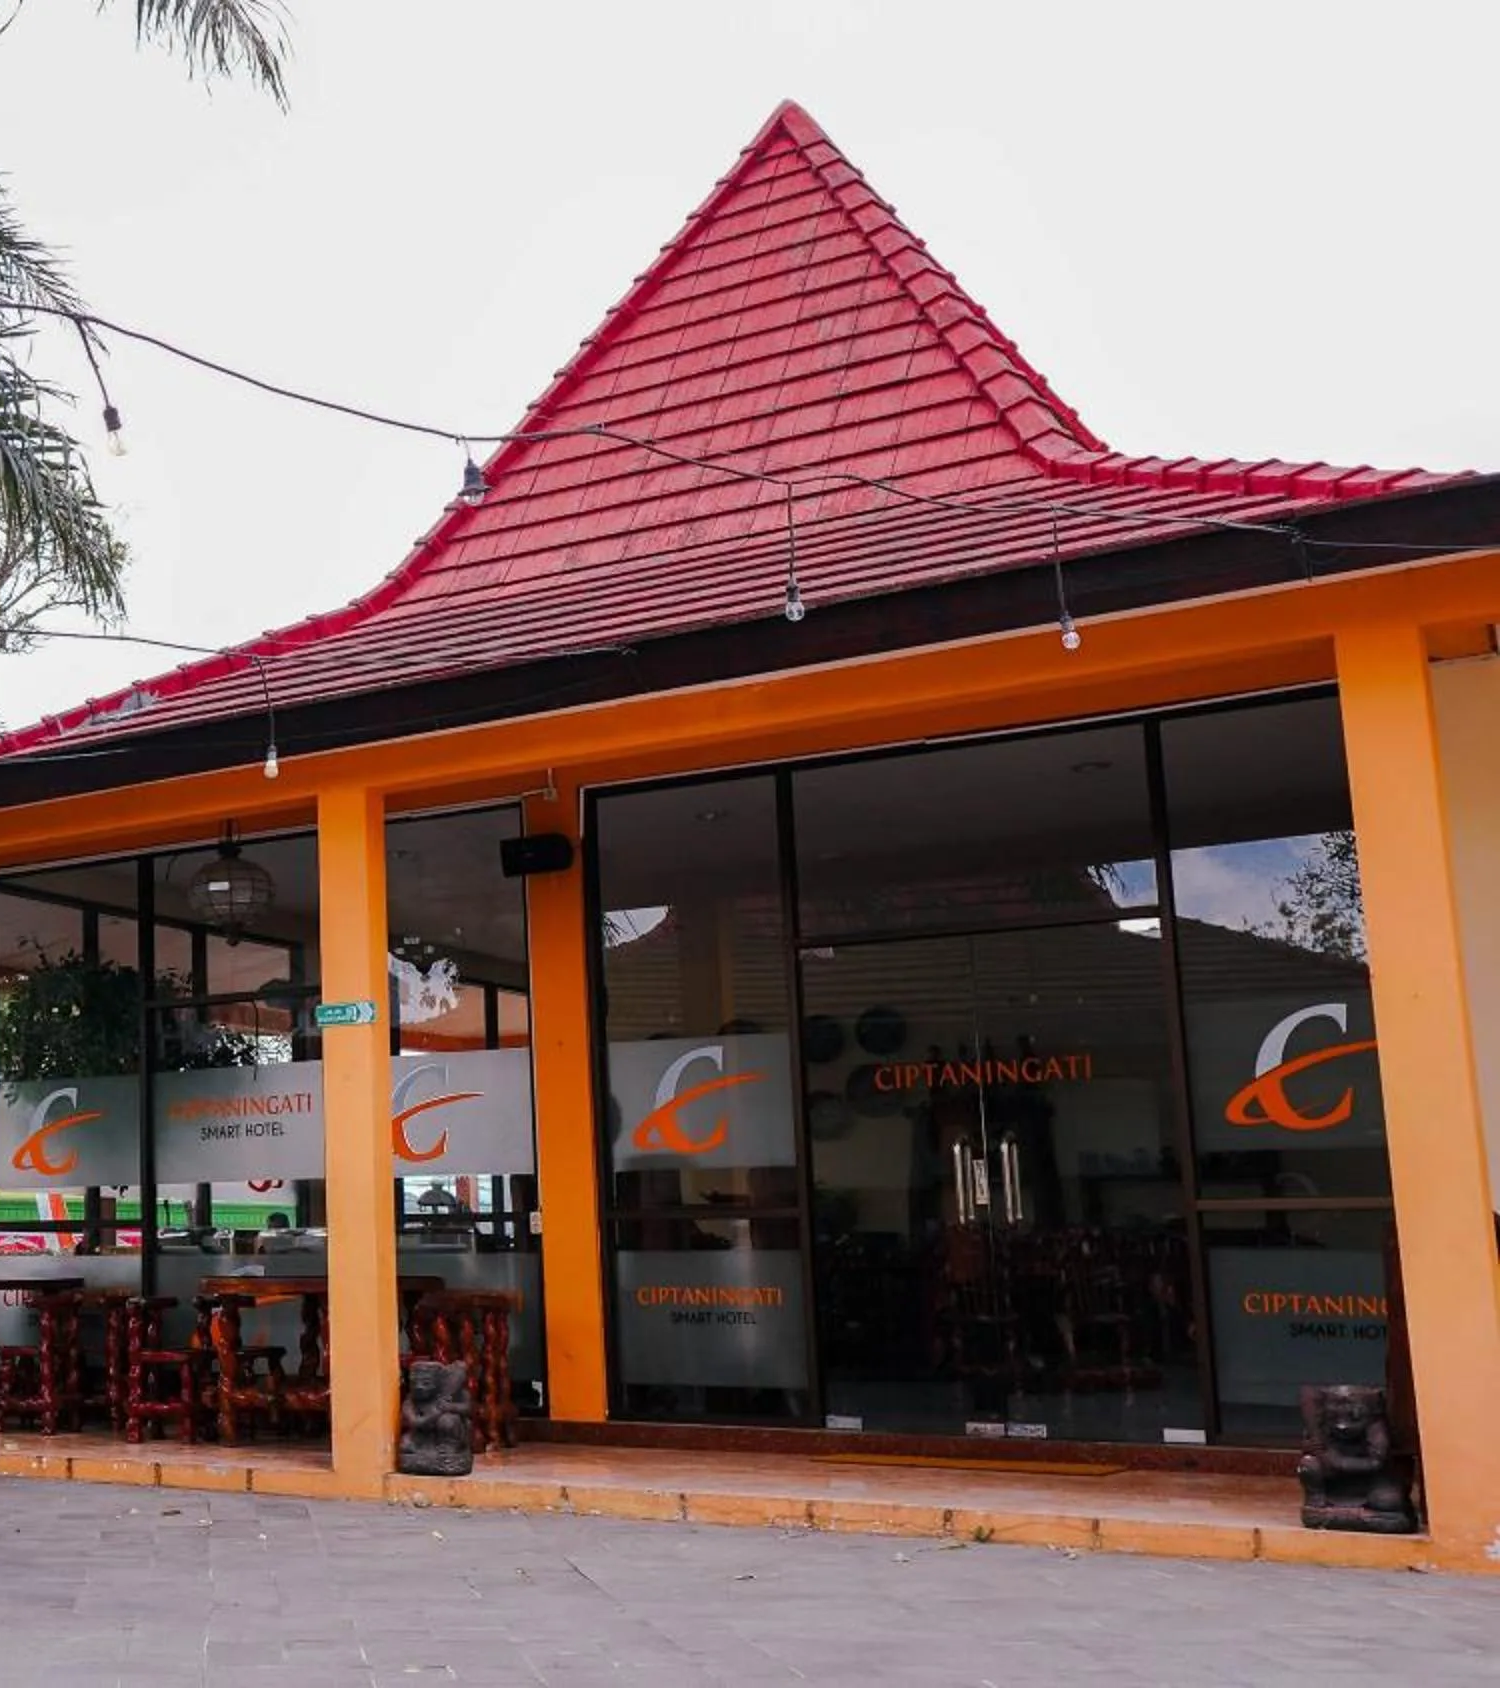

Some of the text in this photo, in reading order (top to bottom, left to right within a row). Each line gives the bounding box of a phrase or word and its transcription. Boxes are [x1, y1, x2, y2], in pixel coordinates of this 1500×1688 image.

[874, 1055, 1092, 1090] CIPTANINGATI
[168, 1092, 312, 1119] ANINGATI
[200, 1121, 285, 1141] SMART HOTEL
[637, 1286, 783, 1306] CIPTANINGATI
[671, 1311, 757, 1325] SMART HOTEL
[1290, 1323, 1346, 1341] SMART
